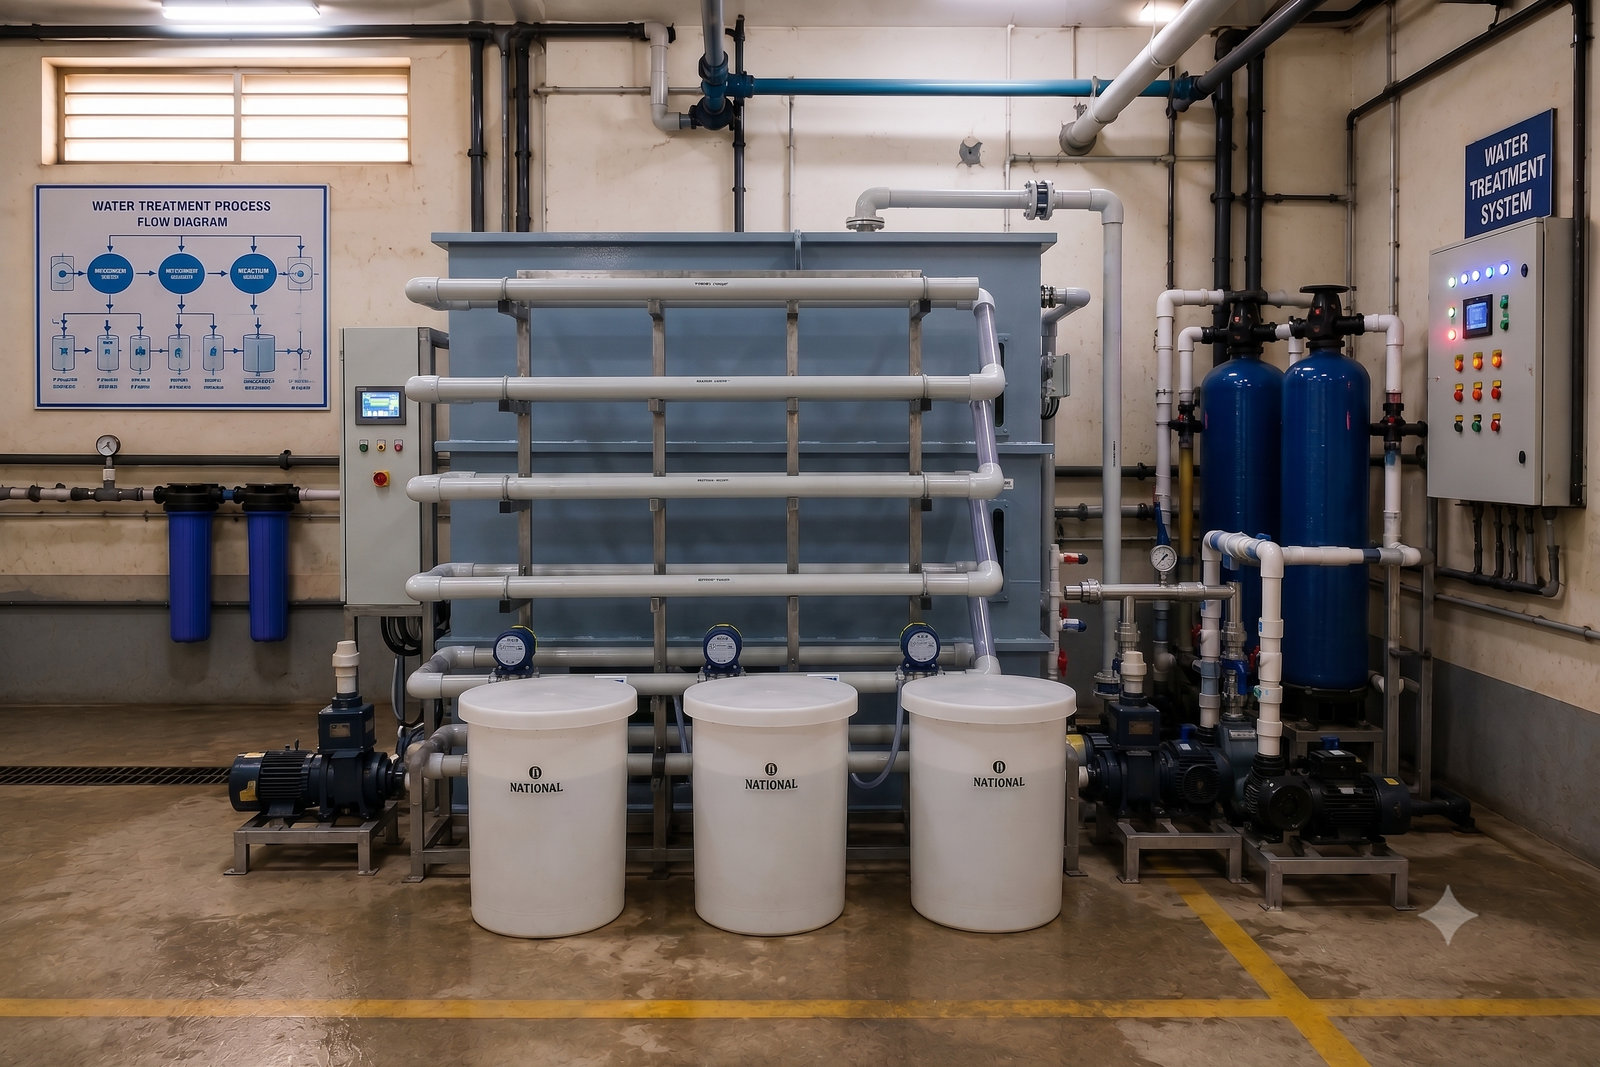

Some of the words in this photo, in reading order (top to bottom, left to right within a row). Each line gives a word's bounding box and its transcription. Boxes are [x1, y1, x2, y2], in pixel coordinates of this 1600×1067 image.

[1484, 132, 1529, 167] WATER
[1469, 153, 1547, 201] TREATMENT
[92, 200, 135, 211] WATER
[138, 200, 211, 211] TREATMENT
[215, 200, 271, 211] PROCESS
[1481, 188, 1533, 225] SYSTEM
[137, 216, 170, 227] FLOW
[173, 216, 228, 227] DIAGRAM
[510, 782, 563, 794] NATIONAL
[745, 778, 798, 790] NATIONAL
[973, 776, 1026, 788] NATIONAL
